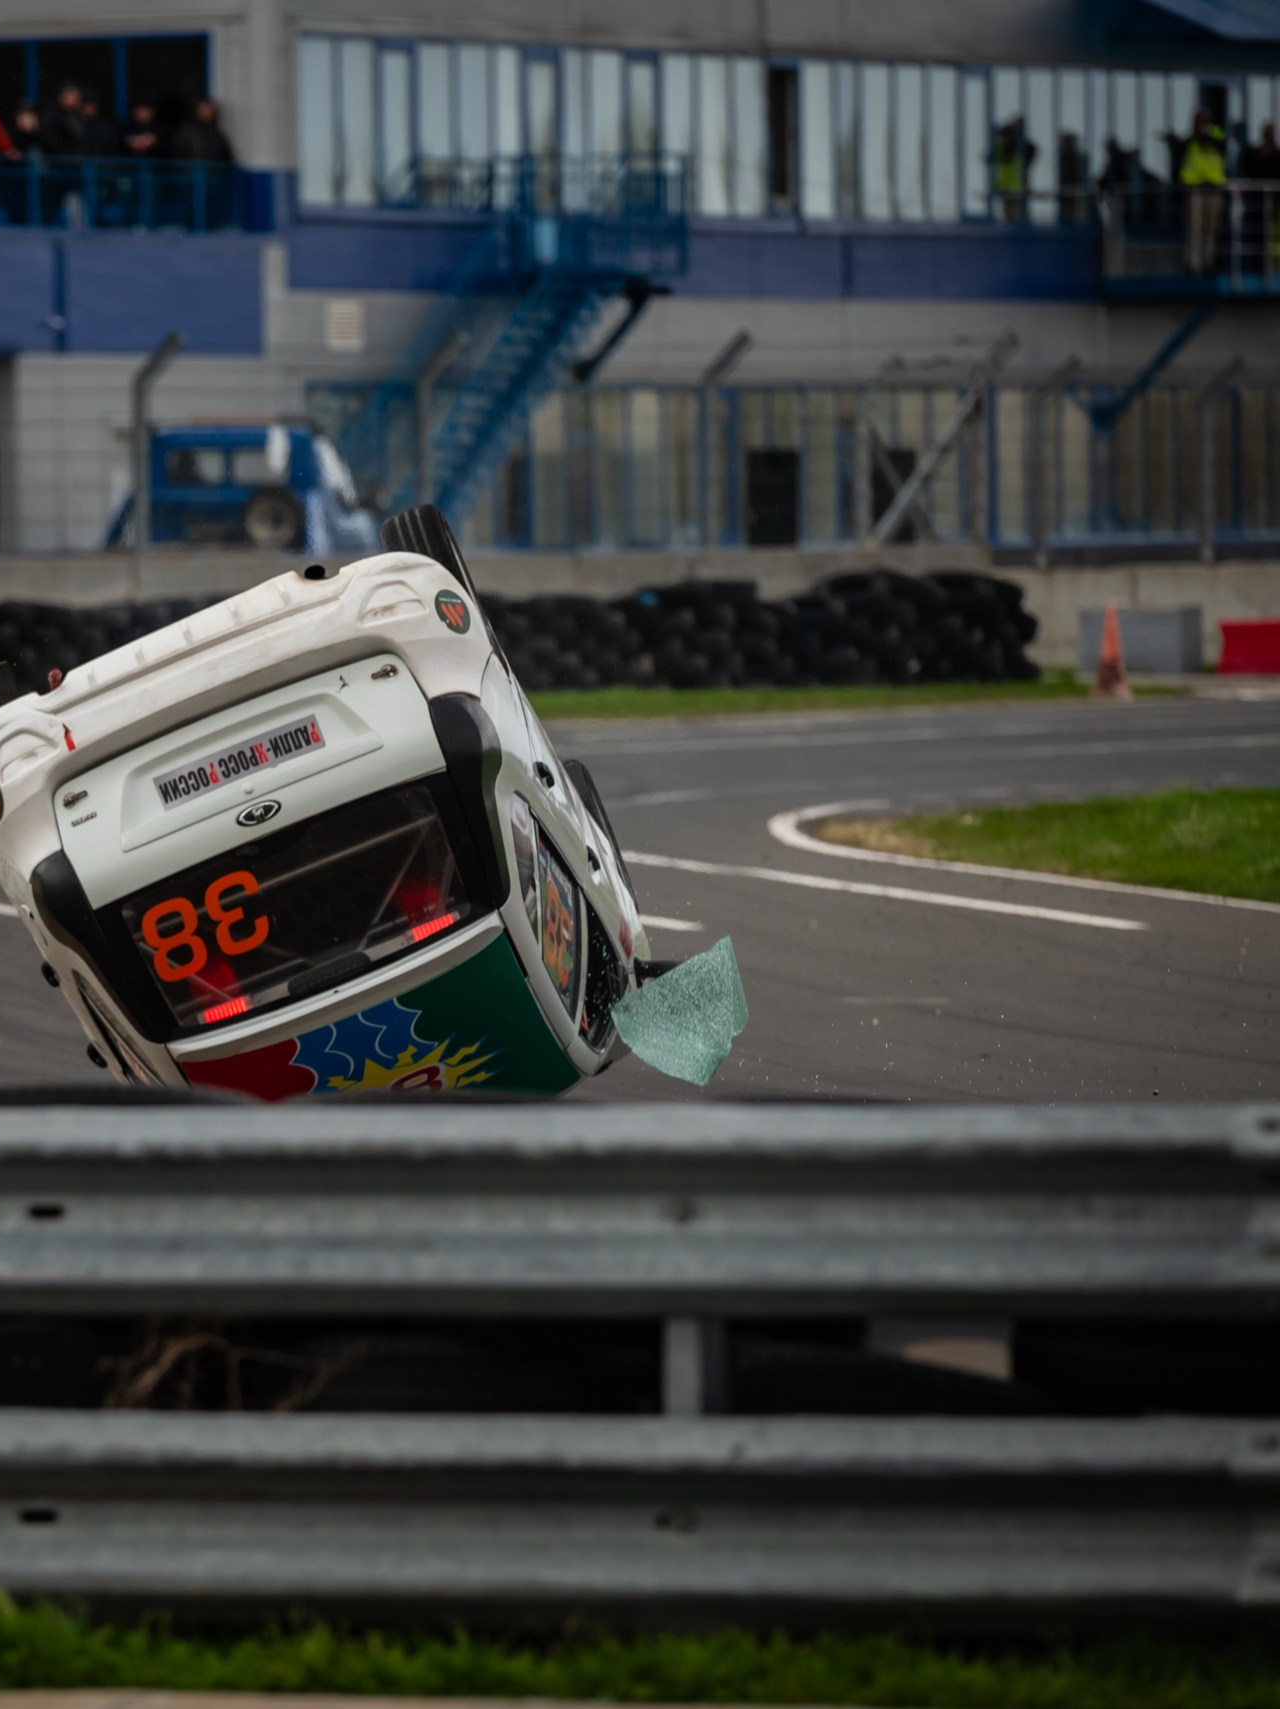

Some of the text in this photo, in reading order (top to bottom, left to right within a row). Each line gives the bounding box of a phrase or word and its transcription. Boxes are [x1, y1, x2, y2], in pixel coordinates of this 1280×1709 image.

[159, 762, 220, 804] РОССИИ
[141, 870, 269, 983] 38
[545, 874, 573, 988] 38
